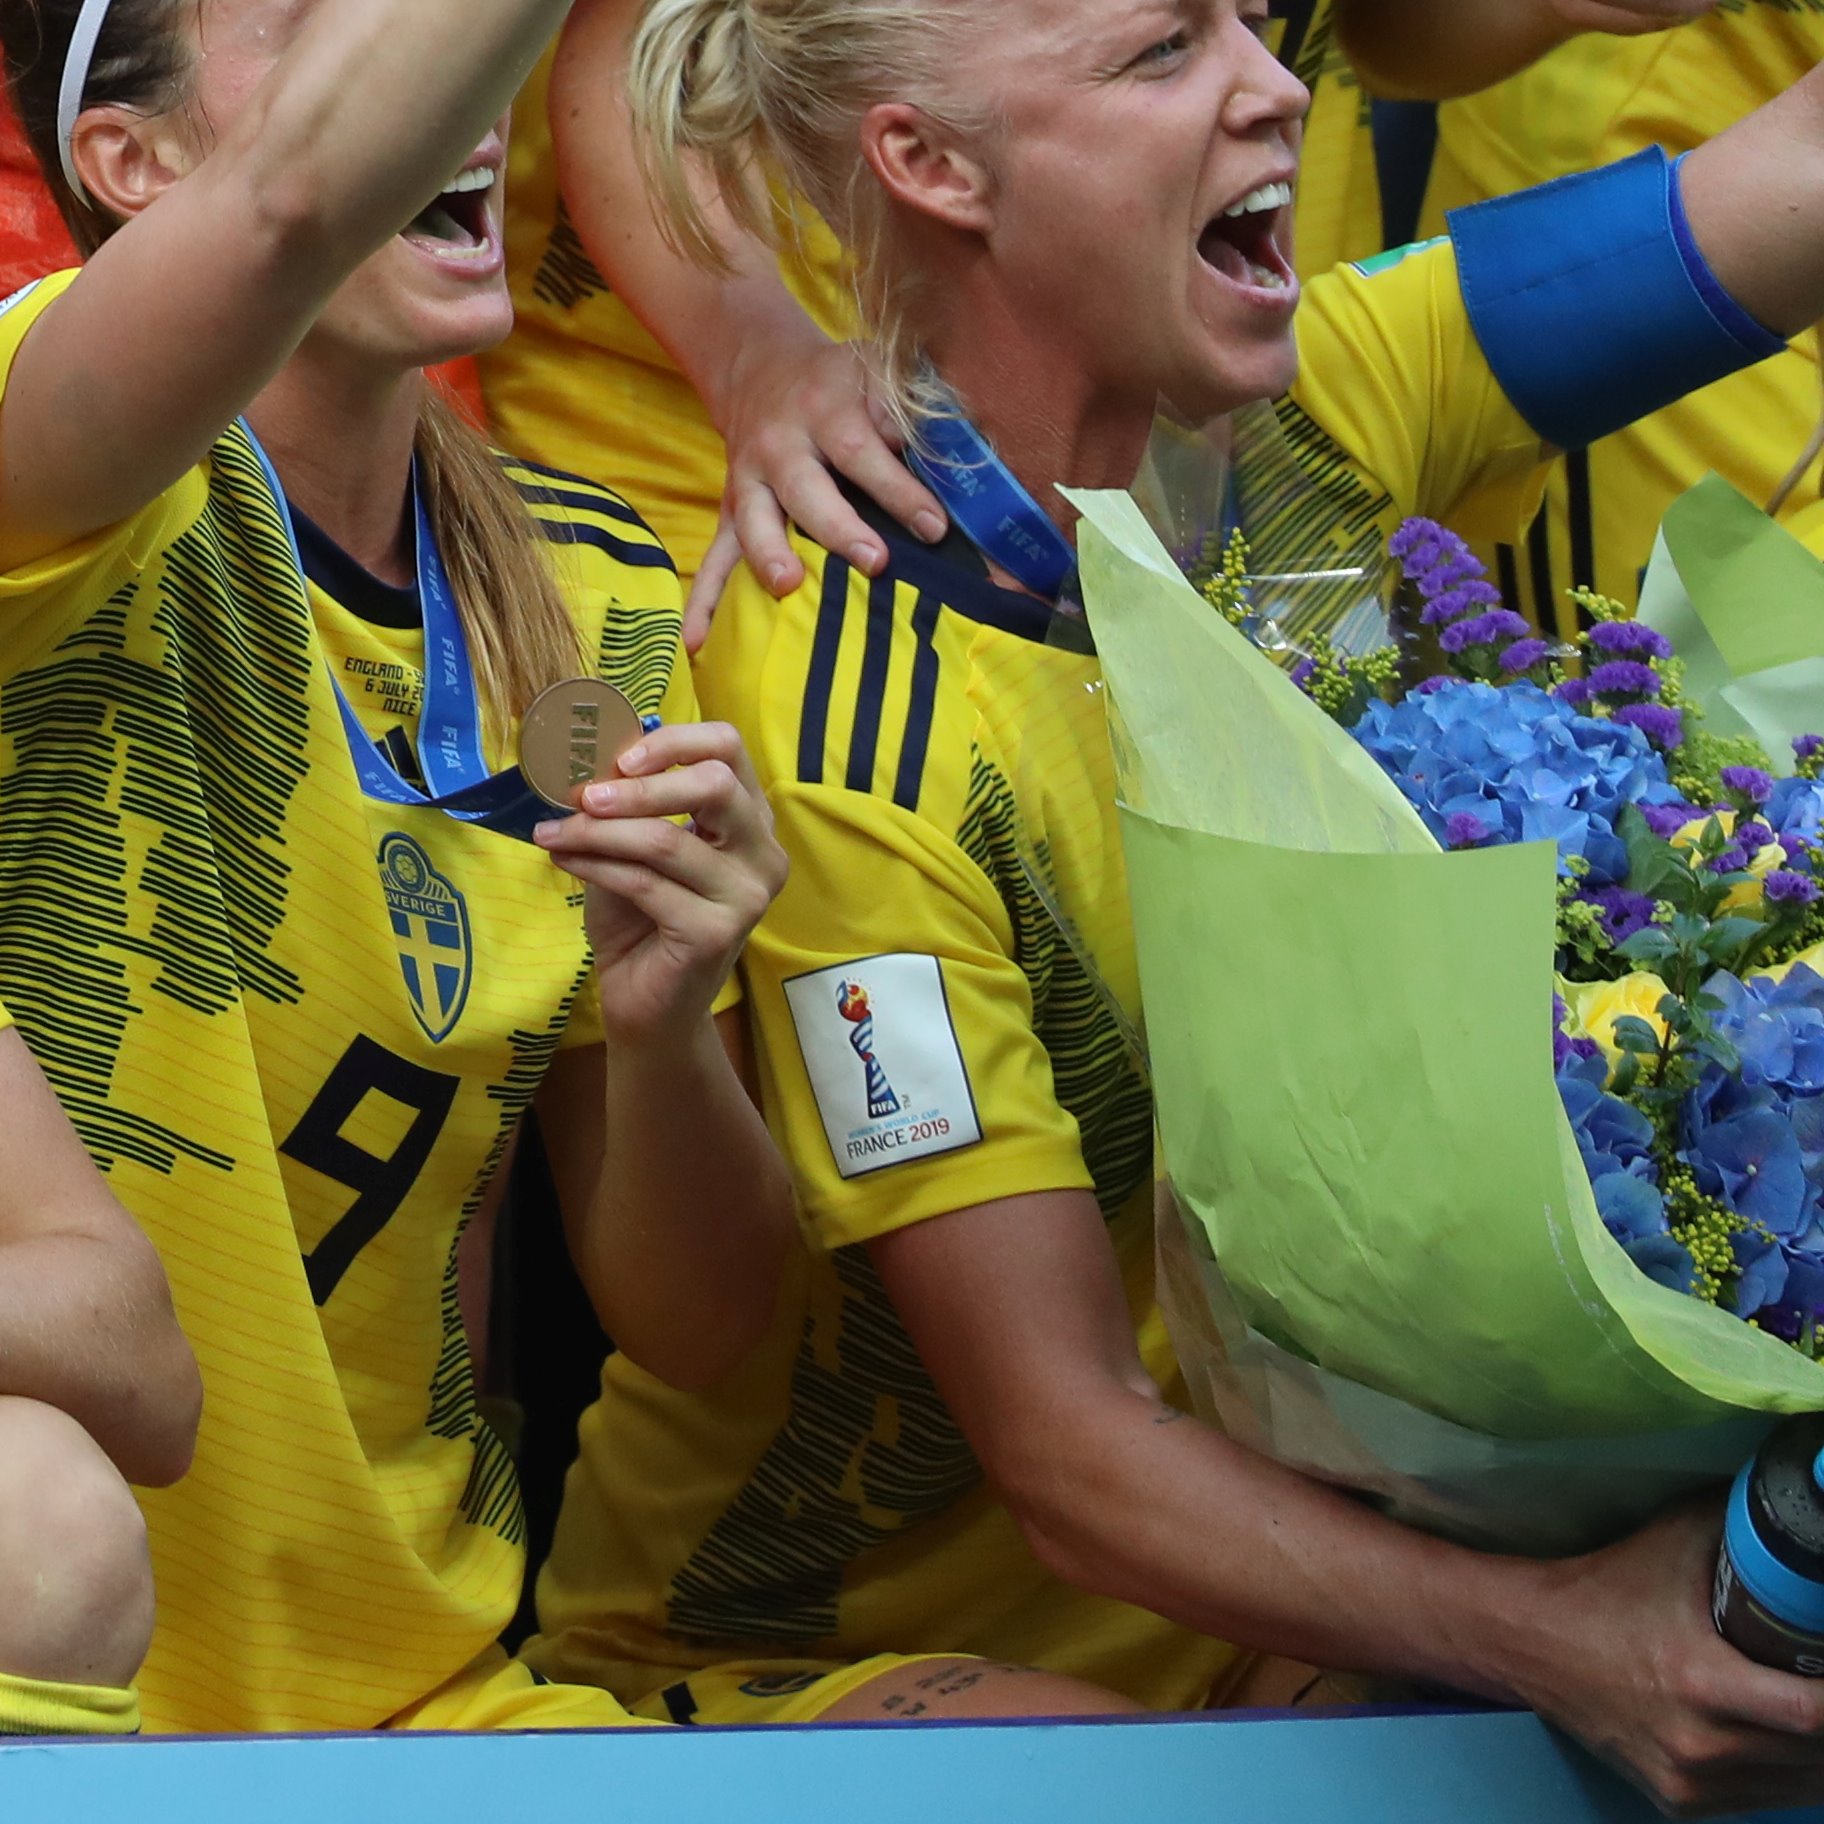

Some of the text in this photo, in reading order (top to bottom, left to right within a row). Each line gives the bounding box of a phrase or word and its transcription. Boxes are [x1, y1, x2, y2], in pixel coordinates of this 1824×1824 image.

[996, 516, 1043, 559] FIFA
[344, 656, 404, 680] ENGLAND
[441, 638, 458, 687] FIFA
[377, 681, 409, 700] JULY
[383, 699, 417, 717] NICE
[441, 725, 458, 773] FIFA
[571, 703, 601, 786] FIFA
[871, 1100, 895, 1115] FIFA
[846, 1118, 950, 1159] FRANCE 2019
[279, 1035, 458, 1306] 9
